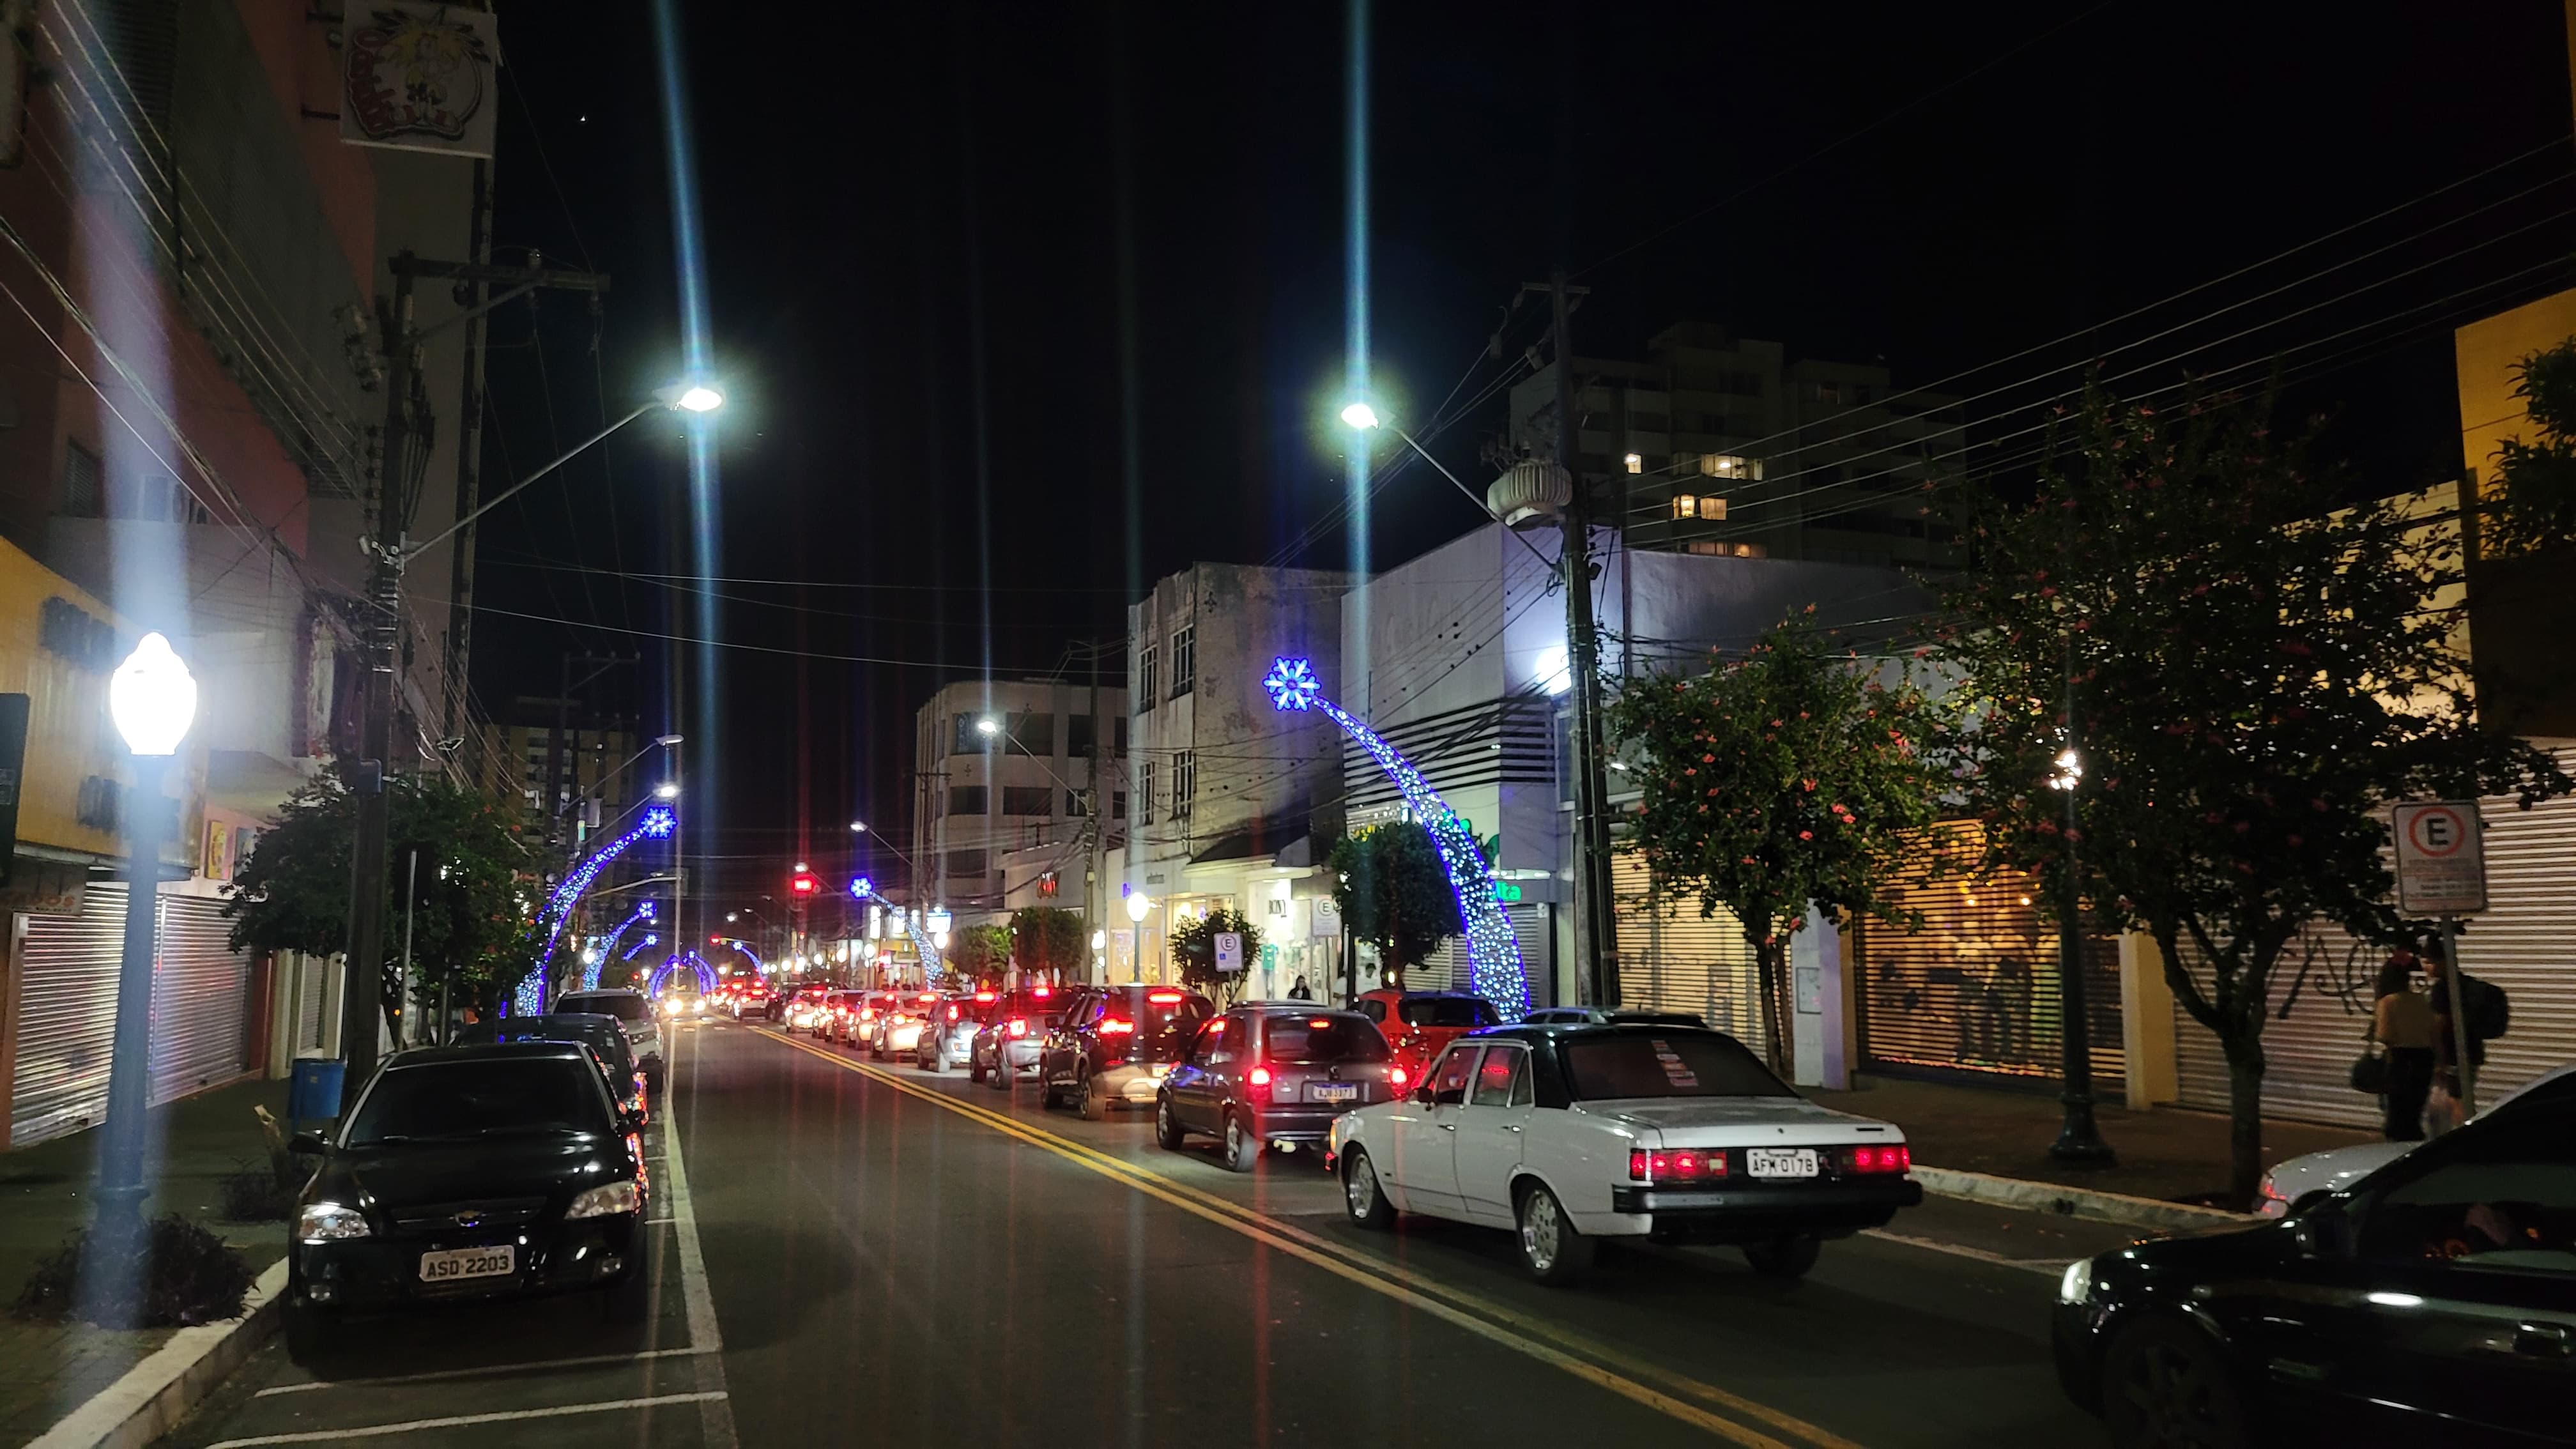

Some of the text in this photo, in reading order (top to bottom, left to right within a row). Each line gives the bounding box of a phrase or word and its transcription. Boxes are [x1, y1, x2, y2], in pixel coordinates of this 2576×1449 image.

[2426, 817, 2449, 846] E
[1322, 902, 1330, 912] E
[1225, 939, 1232, 948] E
